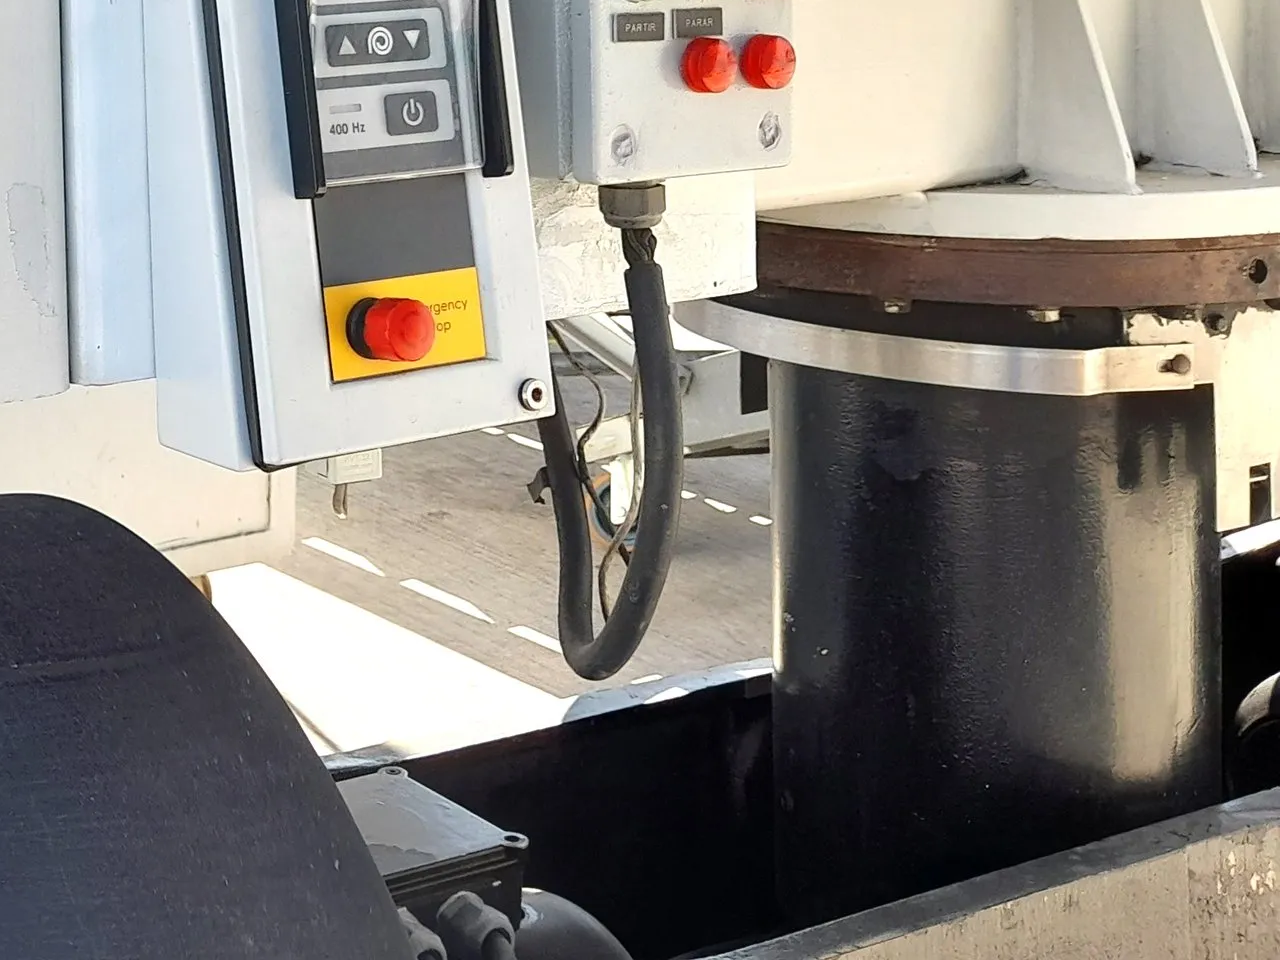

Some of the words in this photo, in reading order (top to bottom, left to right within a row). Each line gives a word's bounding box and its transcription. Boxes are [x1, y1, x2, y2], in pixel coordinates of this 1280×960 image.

[624, 22, 657, 33] PARTIR
[685, 17, 714, 28] PARAR
[329, 123, 349, 136] 400
[351, 122, 366, 134] Hz
[426, 298, 468, 316] rgency
[436, 320, 452, 334] op
